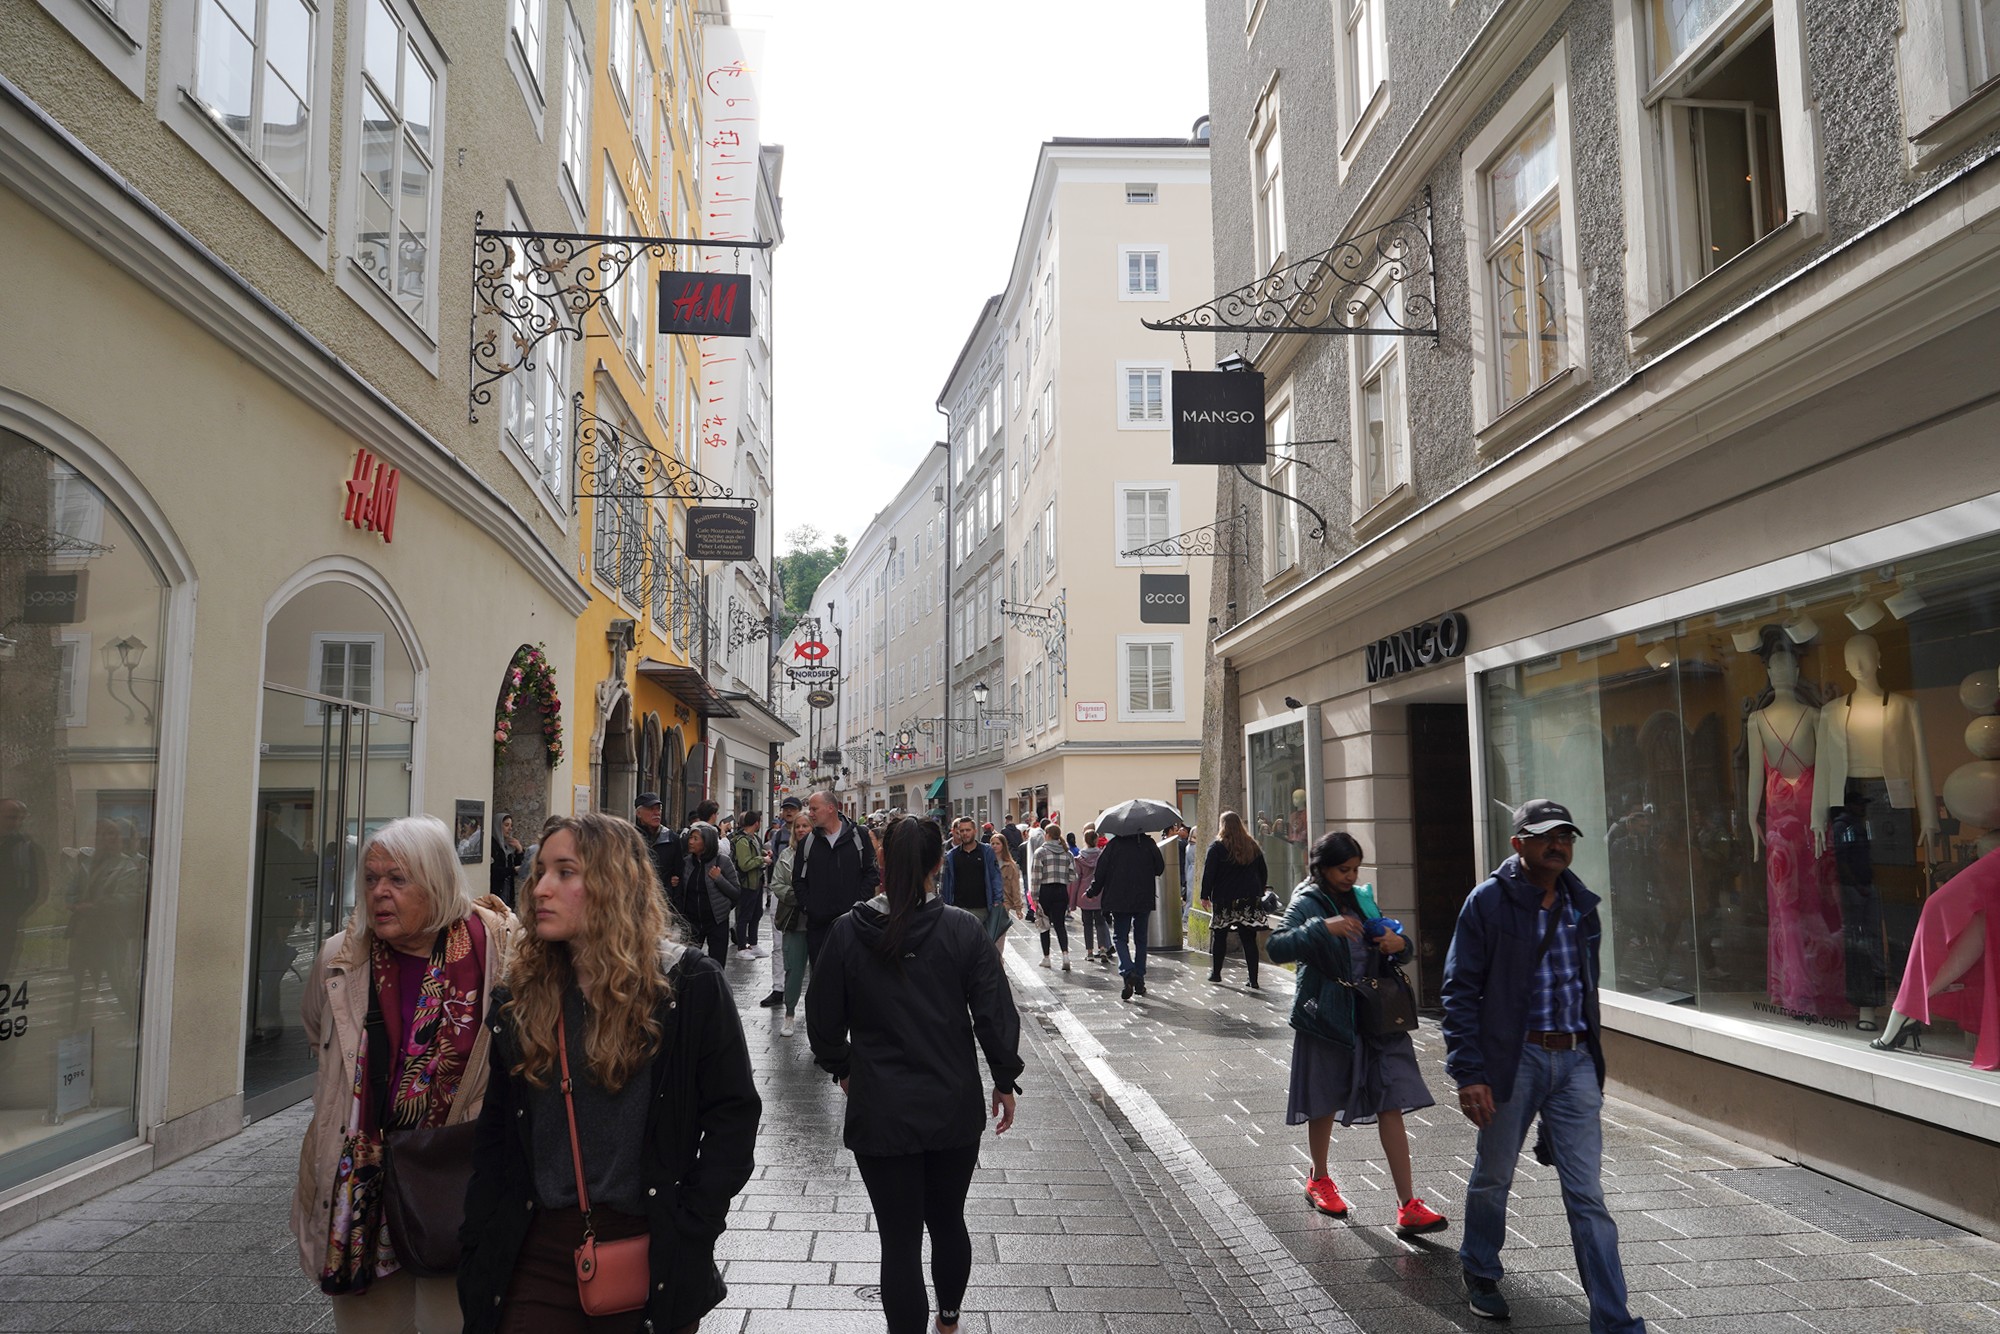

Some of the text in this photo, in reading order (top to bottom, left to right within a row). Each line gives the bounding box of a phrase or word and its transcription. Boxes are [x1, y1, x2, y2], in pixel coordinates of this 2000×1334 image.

[672, 281, 738, 325] H&M
[1183, 410, 1256, 424] MANGO
[344, 448, 400, 544] H&M
[722, 513, 748, 525] Passage
[1145, 593, 1185, 604] ecco
[1365, 611, 1468, 683] MANGO
[795, 670, 830, 678] NORDSEE
[1752, 1000, 1848, 1030] www.mango.com
